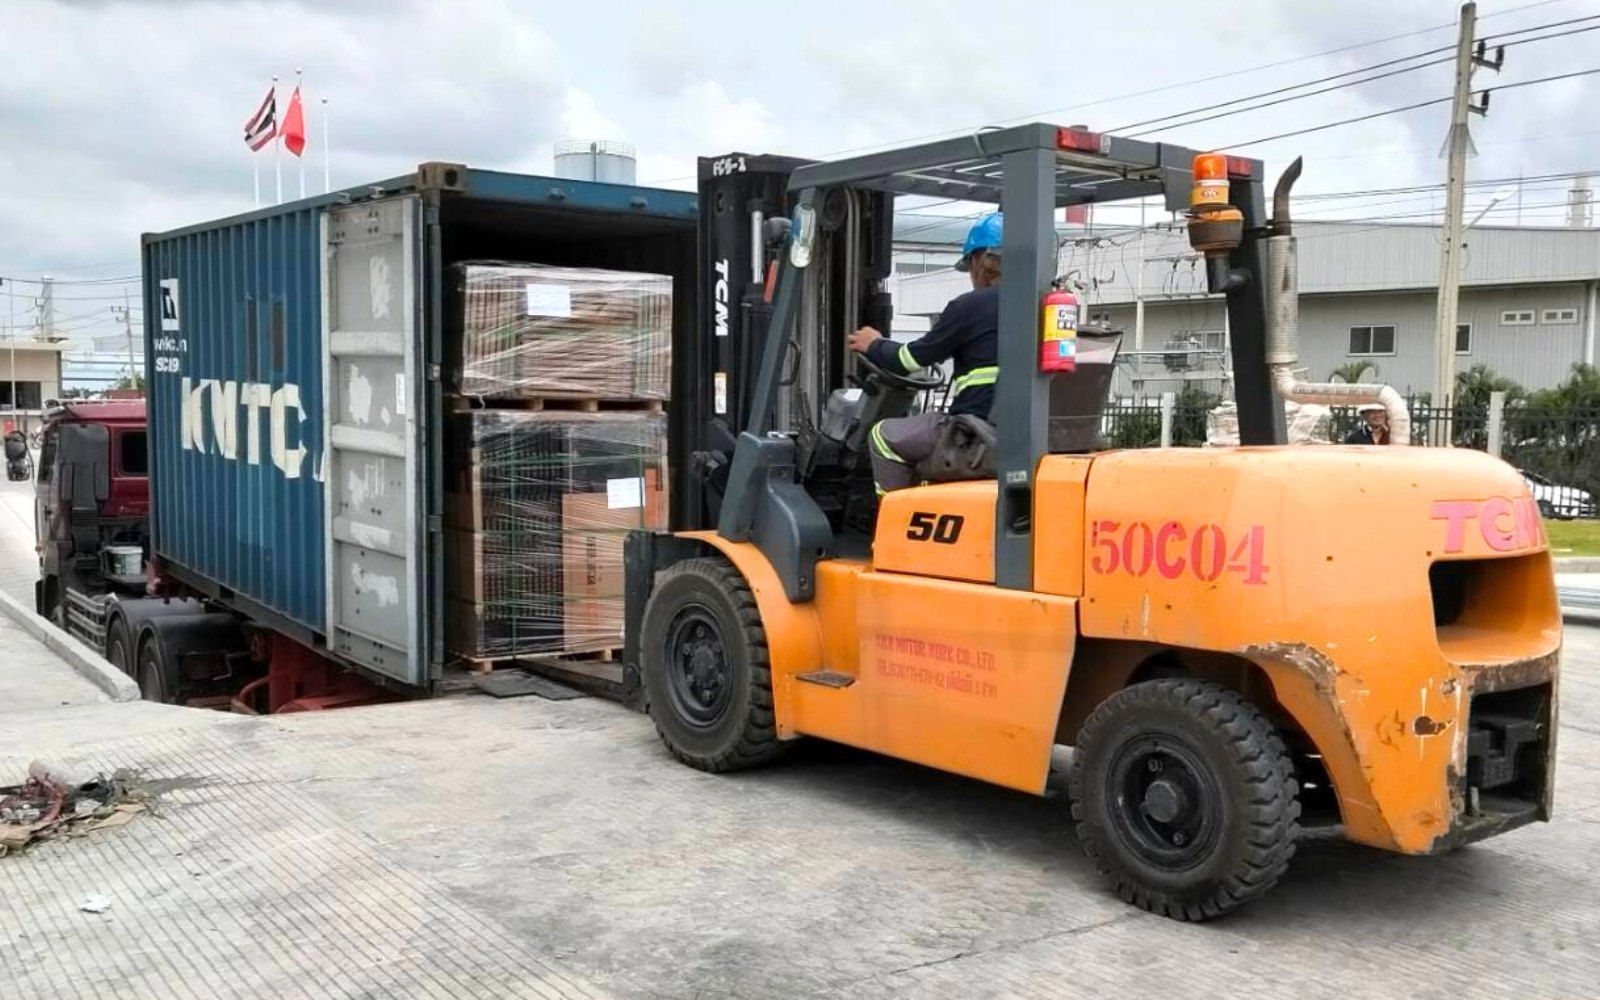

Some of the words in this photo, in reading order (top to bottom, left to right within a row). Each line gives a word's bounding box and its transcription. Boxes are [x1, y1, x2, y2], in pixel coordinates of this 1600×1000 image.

[715, 259, 729, 336] TCM
[906, 511, 965, 544] 50
[1091, 520, 1270, 586] 50C04
